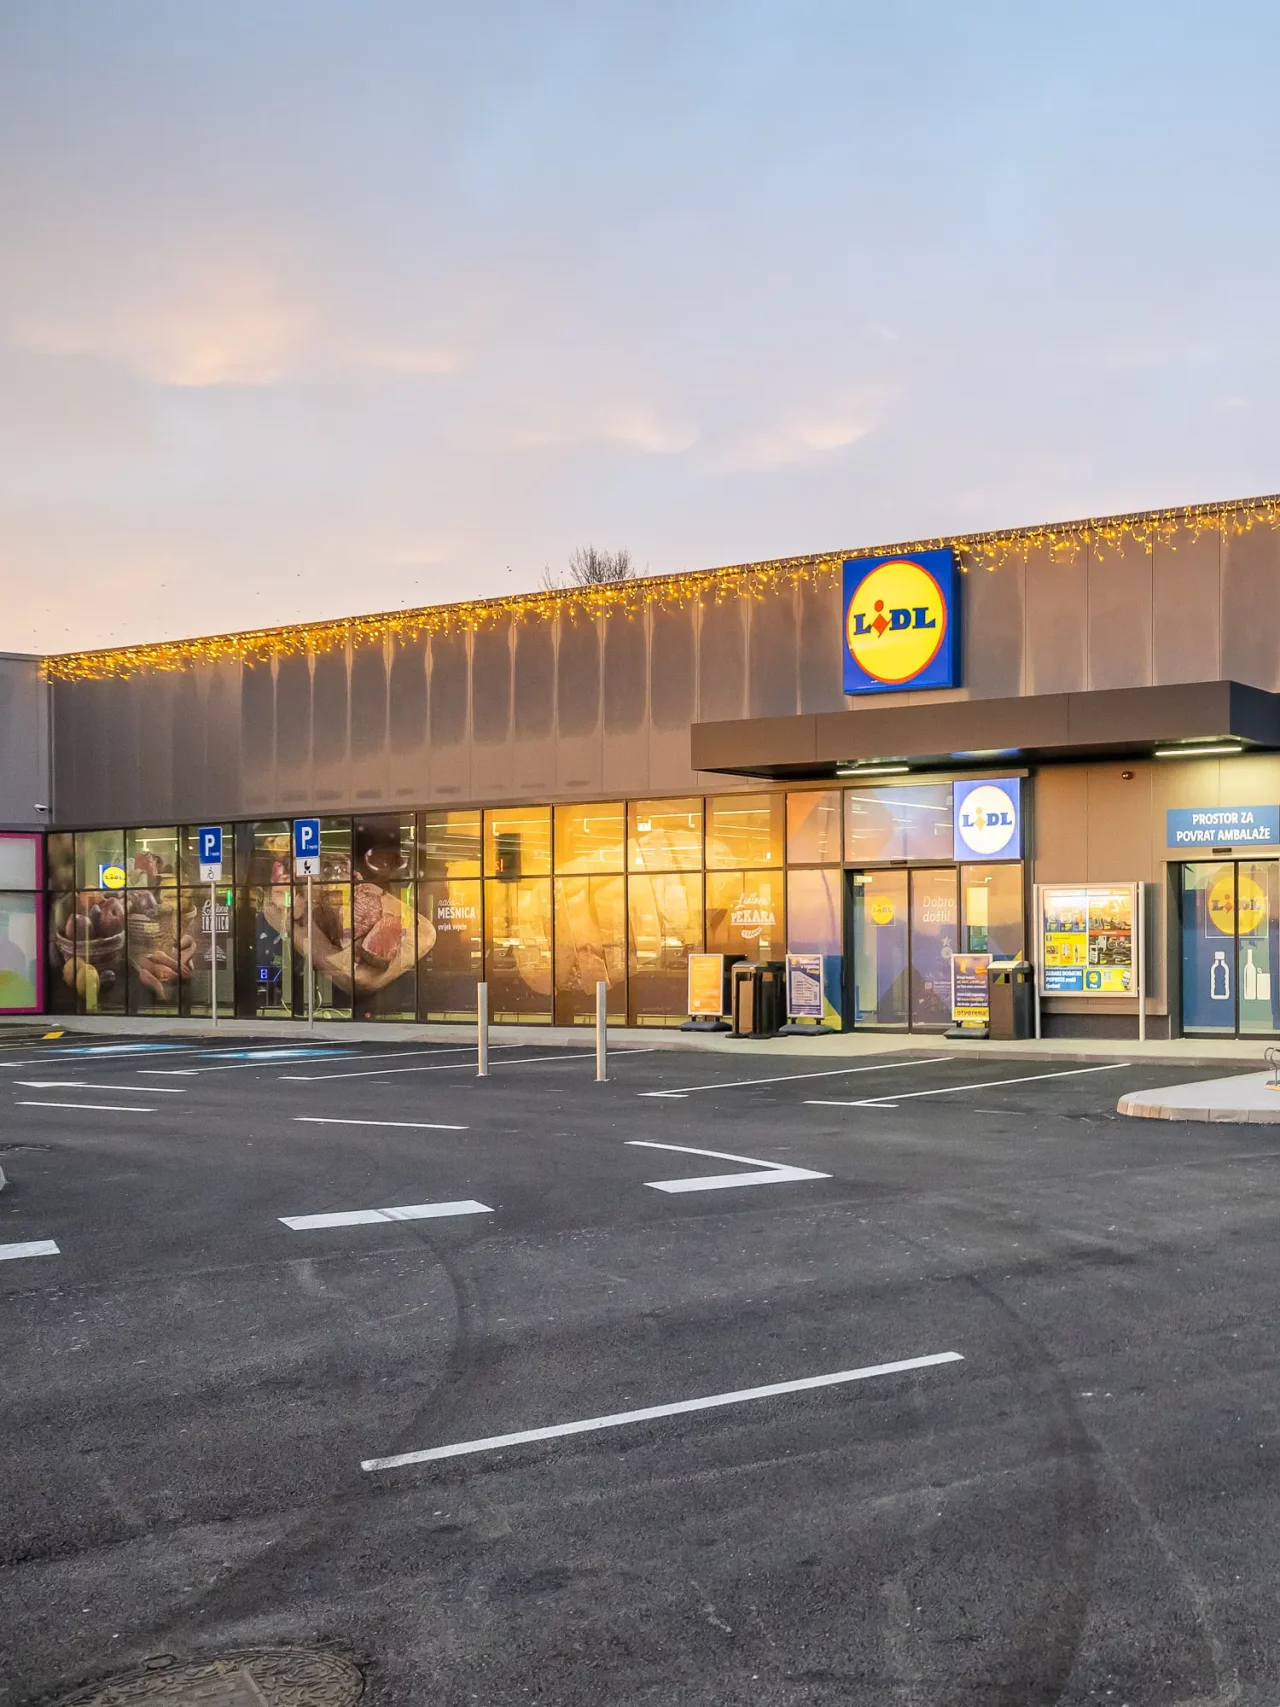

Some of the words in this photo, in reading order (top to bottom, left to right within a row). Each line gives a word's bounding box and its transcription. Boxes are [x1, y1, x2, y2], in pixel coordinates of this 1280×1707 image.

[1192, 812, 1239, 825] PROSTOR
[1240, 811, 1254, 824] ZA
[302, 827, 313, 850] P
[1176, 830, 1216, 842] POVRAT
[1217, 825, 1271, 841] AMBALAŽE
[205, 834, 215, 857] P
[923, 896, 955, 908] Dobro
[437, 907, 476, 919] MESNICA
[731, 909, 776, 922] PEKARA
[923, 911, 951, 923] došli!
